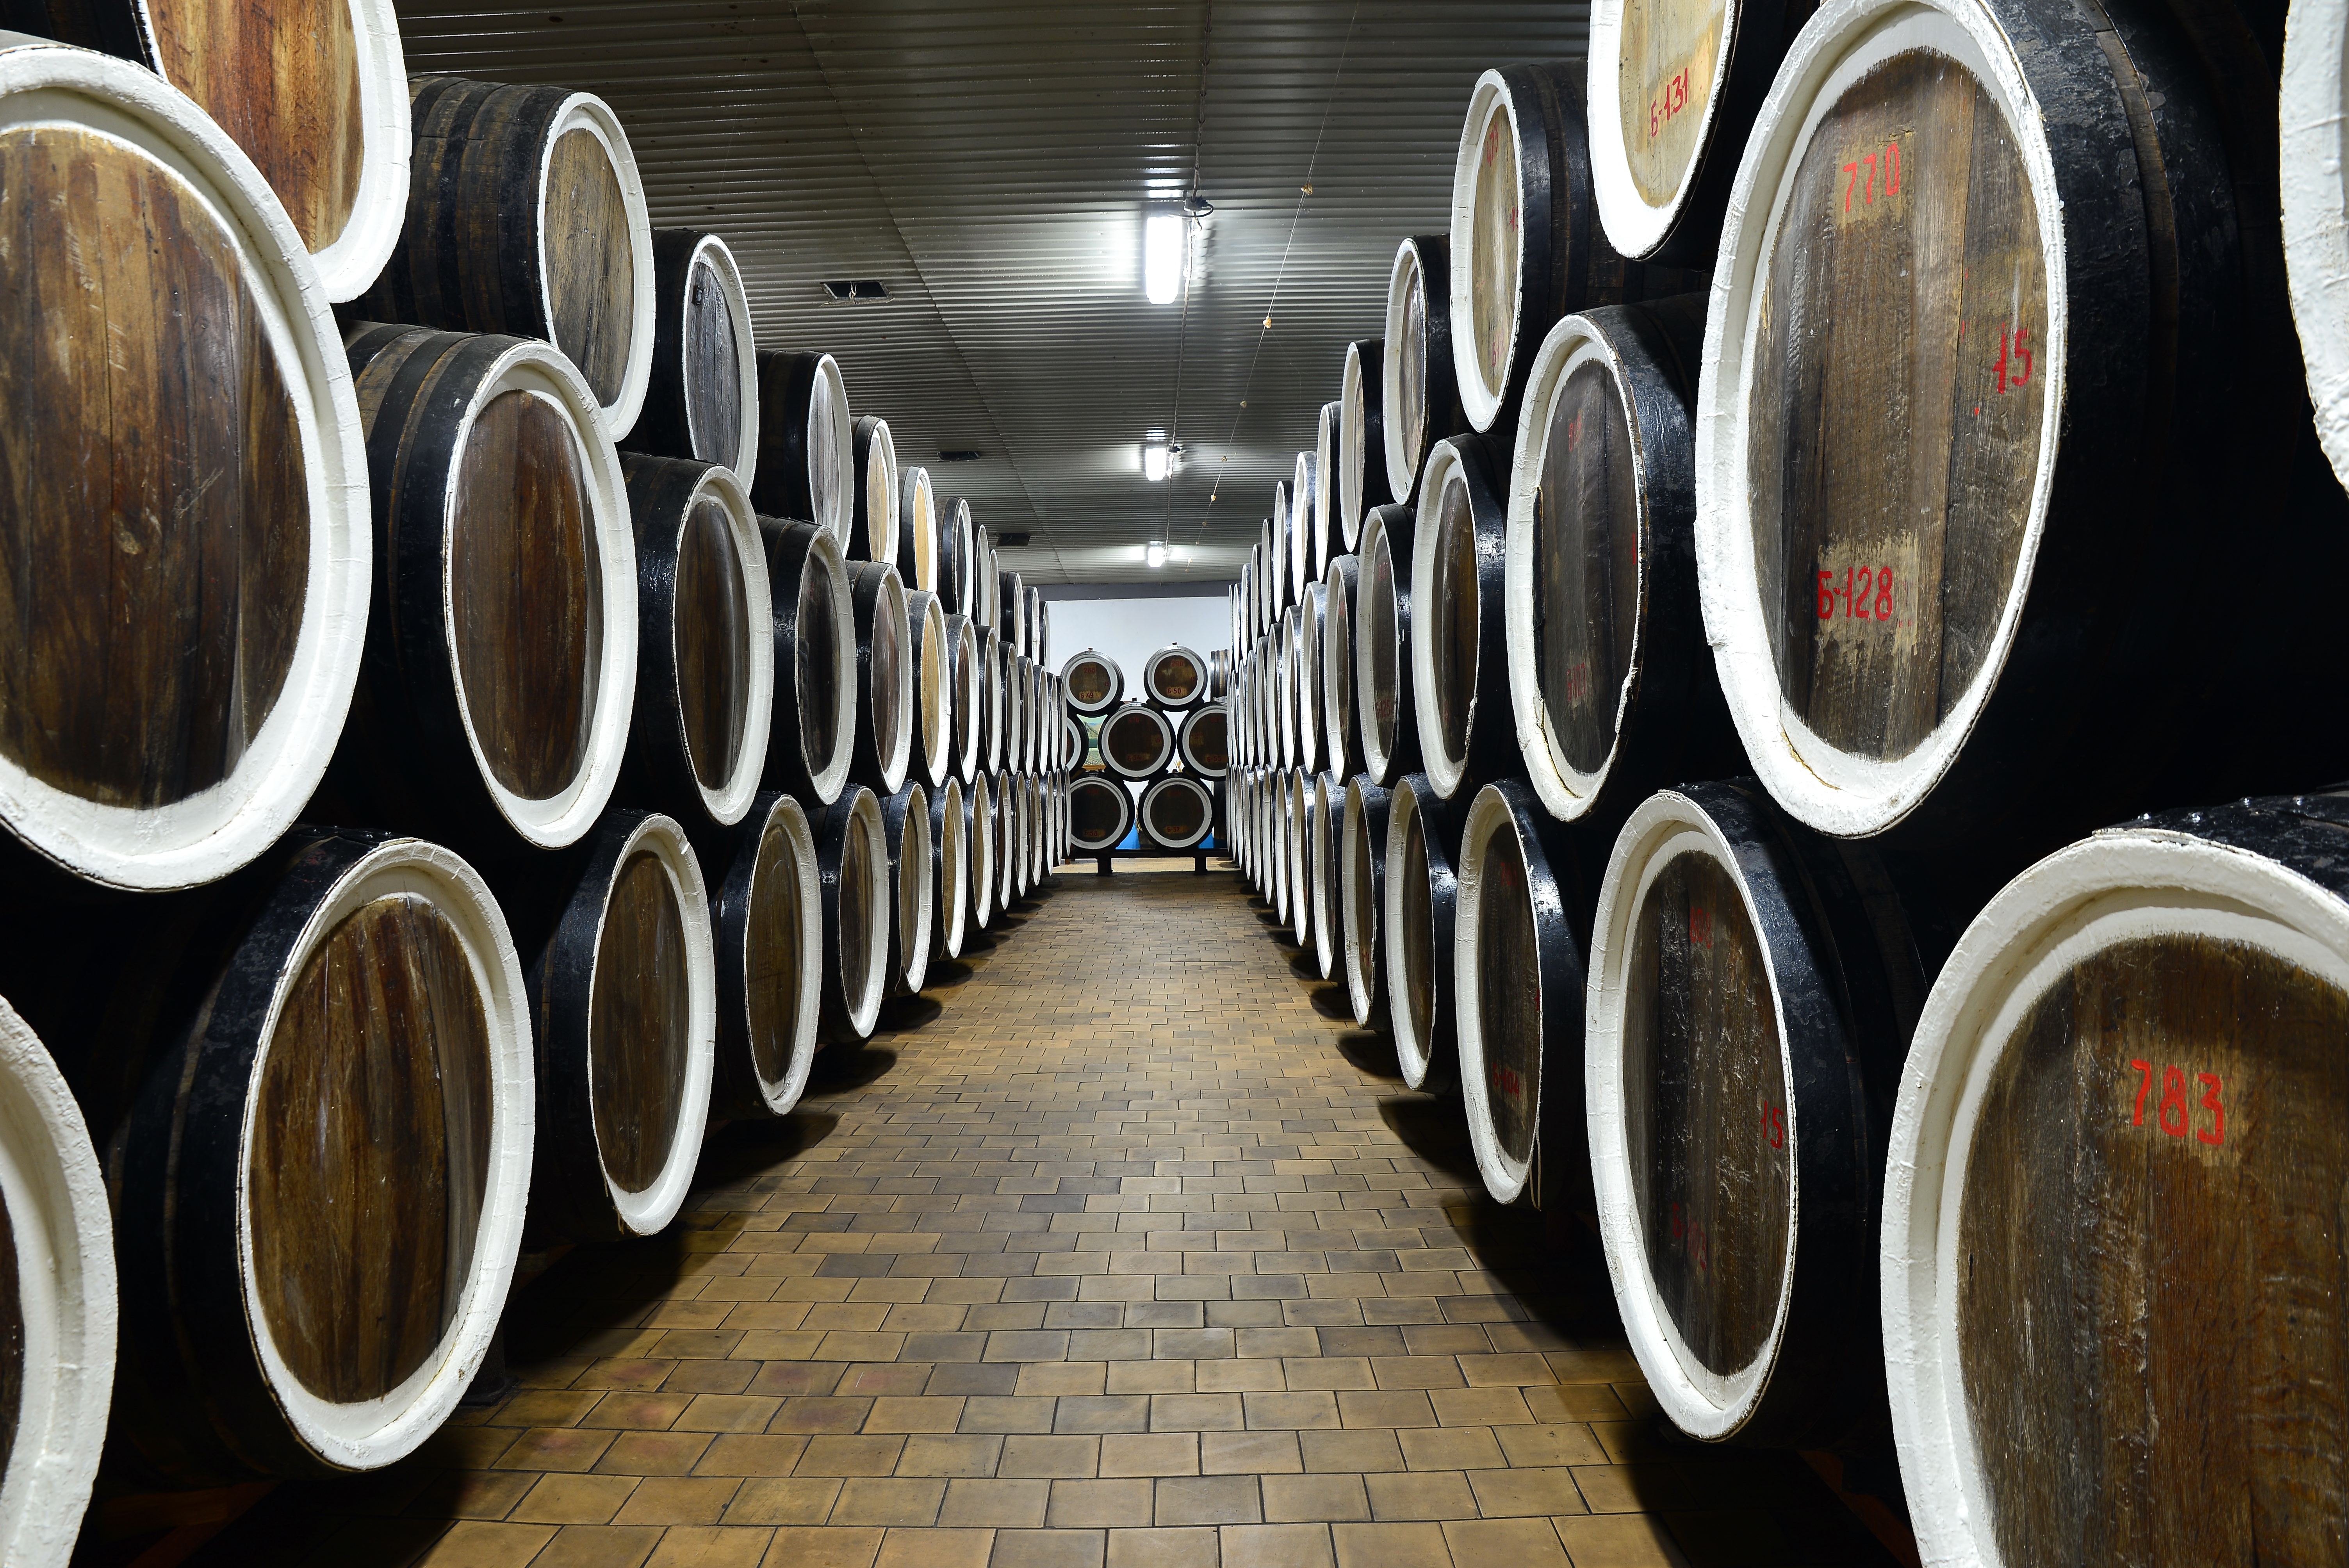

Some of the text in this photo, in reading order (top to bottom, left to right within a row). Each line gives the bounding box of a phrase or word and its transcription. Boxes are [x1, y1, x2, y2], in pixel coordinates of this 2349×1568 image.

[1843, 142, 1900, 213] 770
[1991, 329, 2032, 394] 15
[1690, 907, 1712, 949] 808
[1760, 1100, 1784, 1149] 15
[2131, 1059, 2224, 1146] 783
